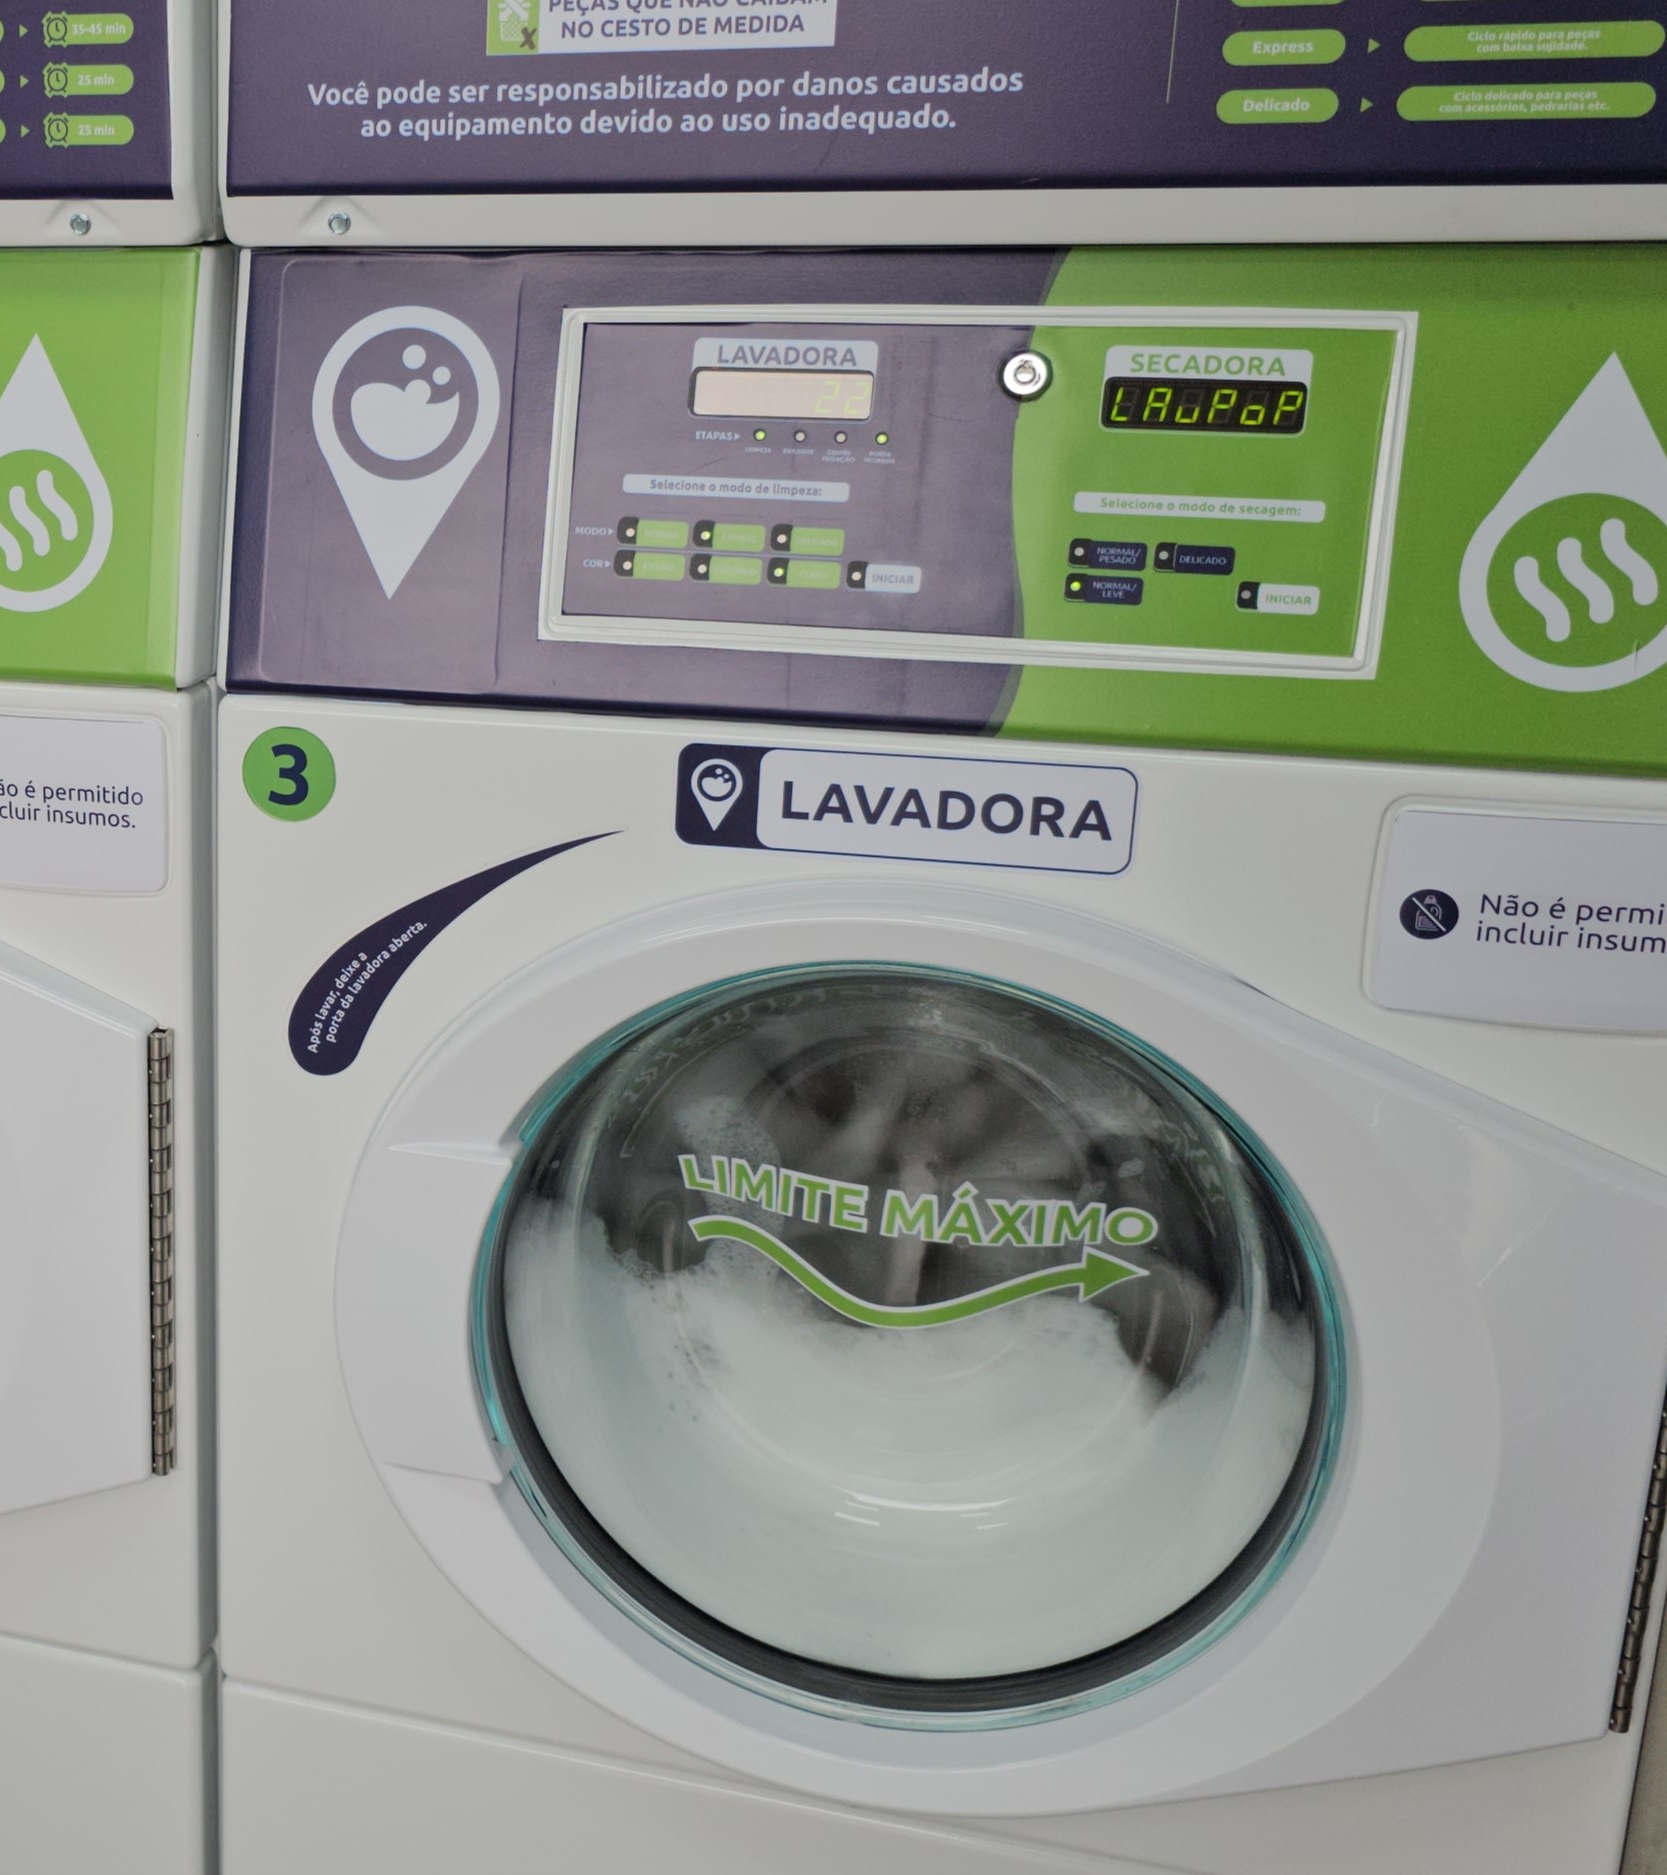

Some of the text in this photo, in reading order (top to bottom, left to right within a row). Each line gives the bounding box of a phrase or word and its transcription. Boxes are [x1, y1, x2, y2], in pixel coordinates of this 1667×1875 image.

[71, 22, 126, 35] 35-45 min
[561, 14, 805, 39] NO CESTO DE MEDIDA
[1252, 40, 1314, 56] Express
[78, 75, 114, 86] 25 min
[307, 66, 1024, 109] Você pode ser responsabilizado por danos causados
[1242, 98, 1311, 113] Delicado
[78, 125, 114, 136] 25 min
[361, 102, 957, 142] ao equipamento devido ao uso inadequado.
[717, 344, 857, 367] LAVADORA
[1129, 354, 1286, 376] SECADORA
[813, 380, 872, 415] 22
[695, 431, 732, 440] ETAPAS
[650, 479, 822, 497] Selecione o modo de limpeza:
[1100, 497, 1301, 517] Selecione o modo de secagem:
[575, 527, 606, 536] MODO
[1097, 547, 1141, 557] NORMAL/
[1099, 555, 1136, 565] PESADO
[1179, 555, 1226, 566] DELICADO
[583, 559, 604, 568] COR
[872, 573, 915, 585] INICIAR
[1093, 581, 1136, 592] NORMAL/
[1102, 590, 1124, 599] LEVE
[1265, 594, 1312, 606] INICIAR
[268, 743, 309, 806] 3
[25, 781, 35, 798] é
[43, 785, 143, 806] permitido
[47, 805, 136, 828] insumos.
[781, 781, 1112, 841] LAVADORA
[1480, 894, 1667, 925] Não é permi
[1476, 920, 1569, 947] incluir
[326, 922, 428, 1043] porta da lavadora aberta.
[307, 952, 368, 1054] Após lavar, deixe a
[678, 1154, 1158, 1247] LIMITE MÁXIMO
